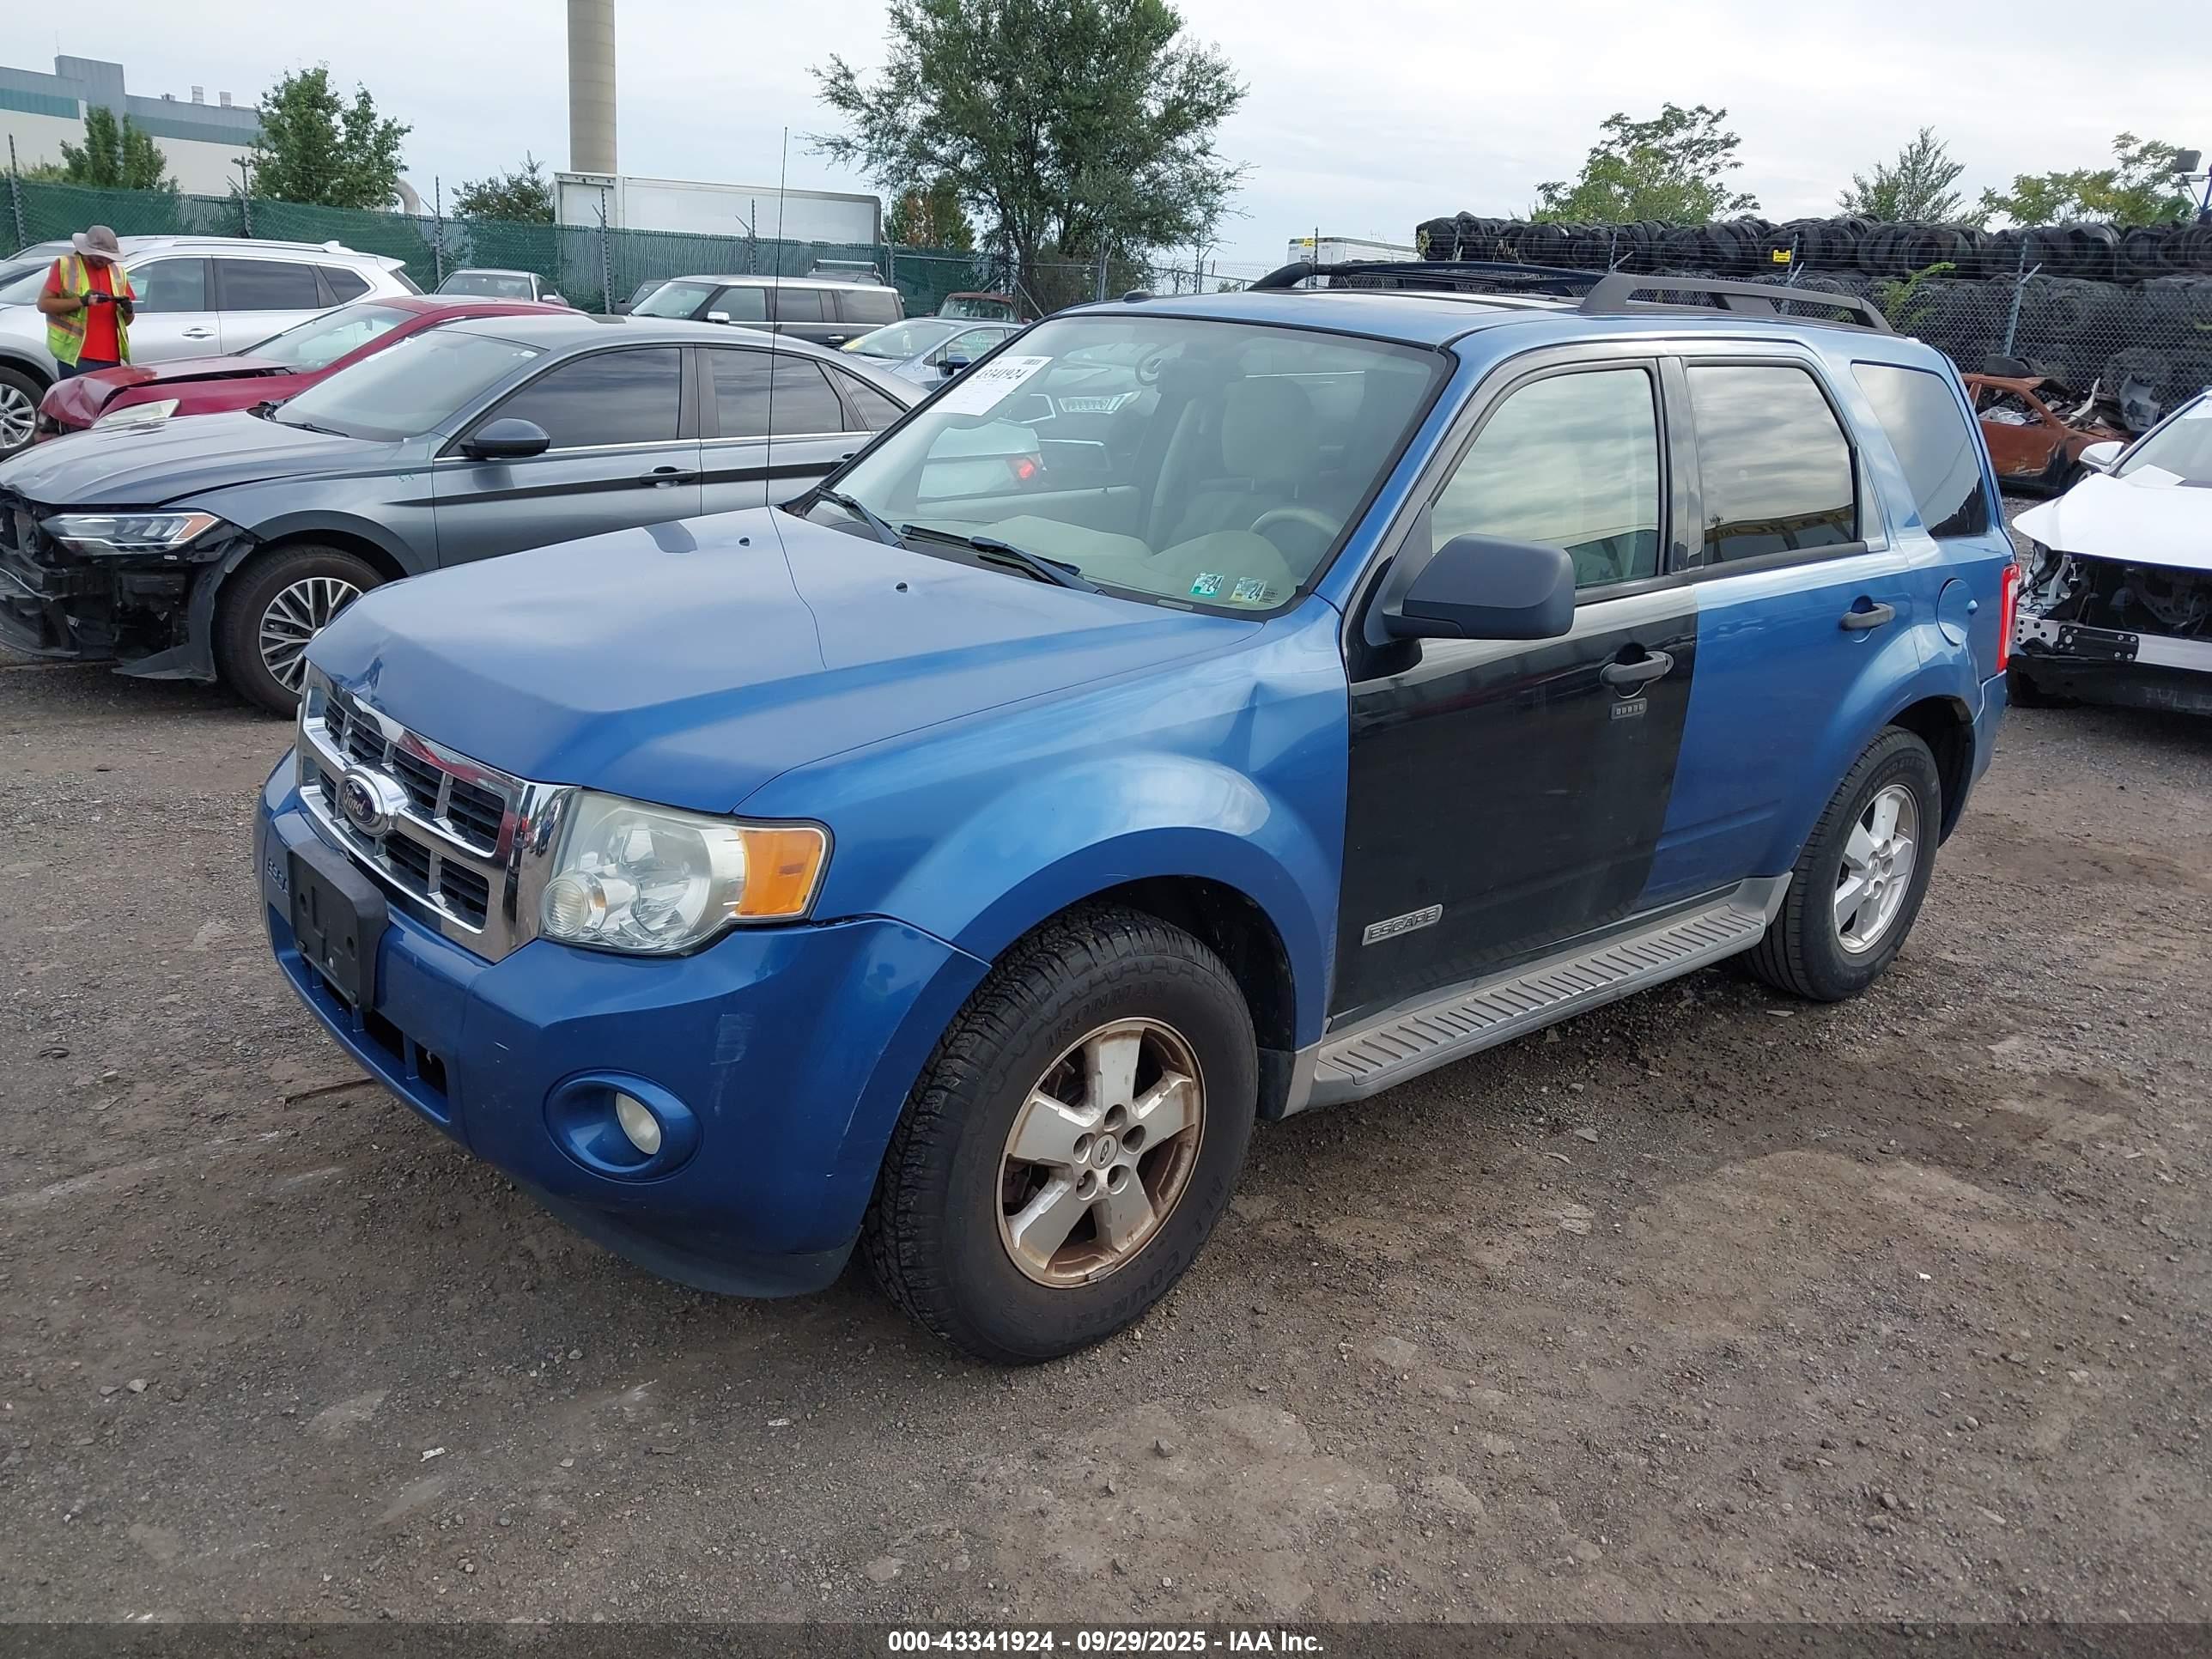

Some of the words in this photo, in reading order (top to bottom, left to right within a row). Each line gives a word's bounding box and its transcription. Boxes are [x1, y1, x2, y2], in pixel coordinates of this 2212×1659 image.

[1207, 576, 1223, 592] 24
[1249, 583, 1265, 601] 24
[343, 781, 366, 817] Ford
[1368, 908, 1437, 940] ESCAPE
